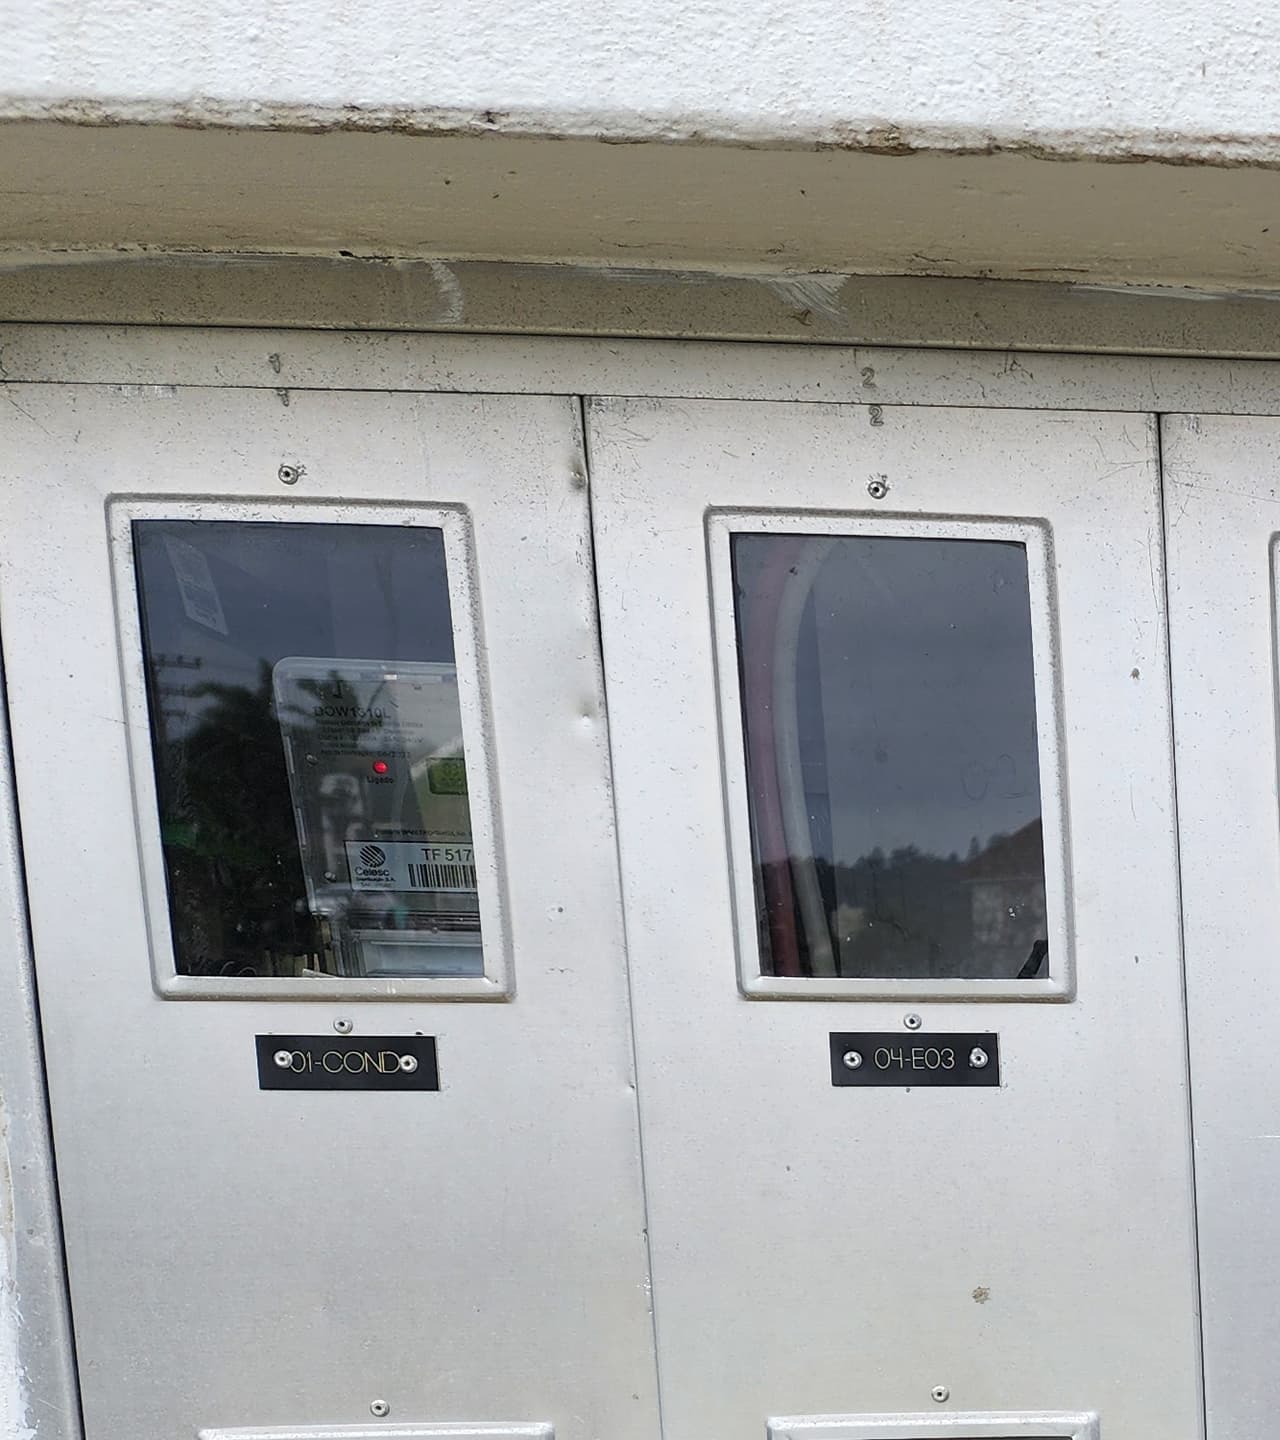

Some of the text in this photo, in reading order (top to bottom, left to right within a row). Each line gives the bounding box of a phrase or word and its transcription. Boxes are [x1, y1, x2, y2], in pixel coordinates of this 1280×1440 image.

[422, 849, 474, 862] TF 517
[289, 1051, 402, 1073] 01-COND
[874, 1048, 956, 1071] 04-E03
